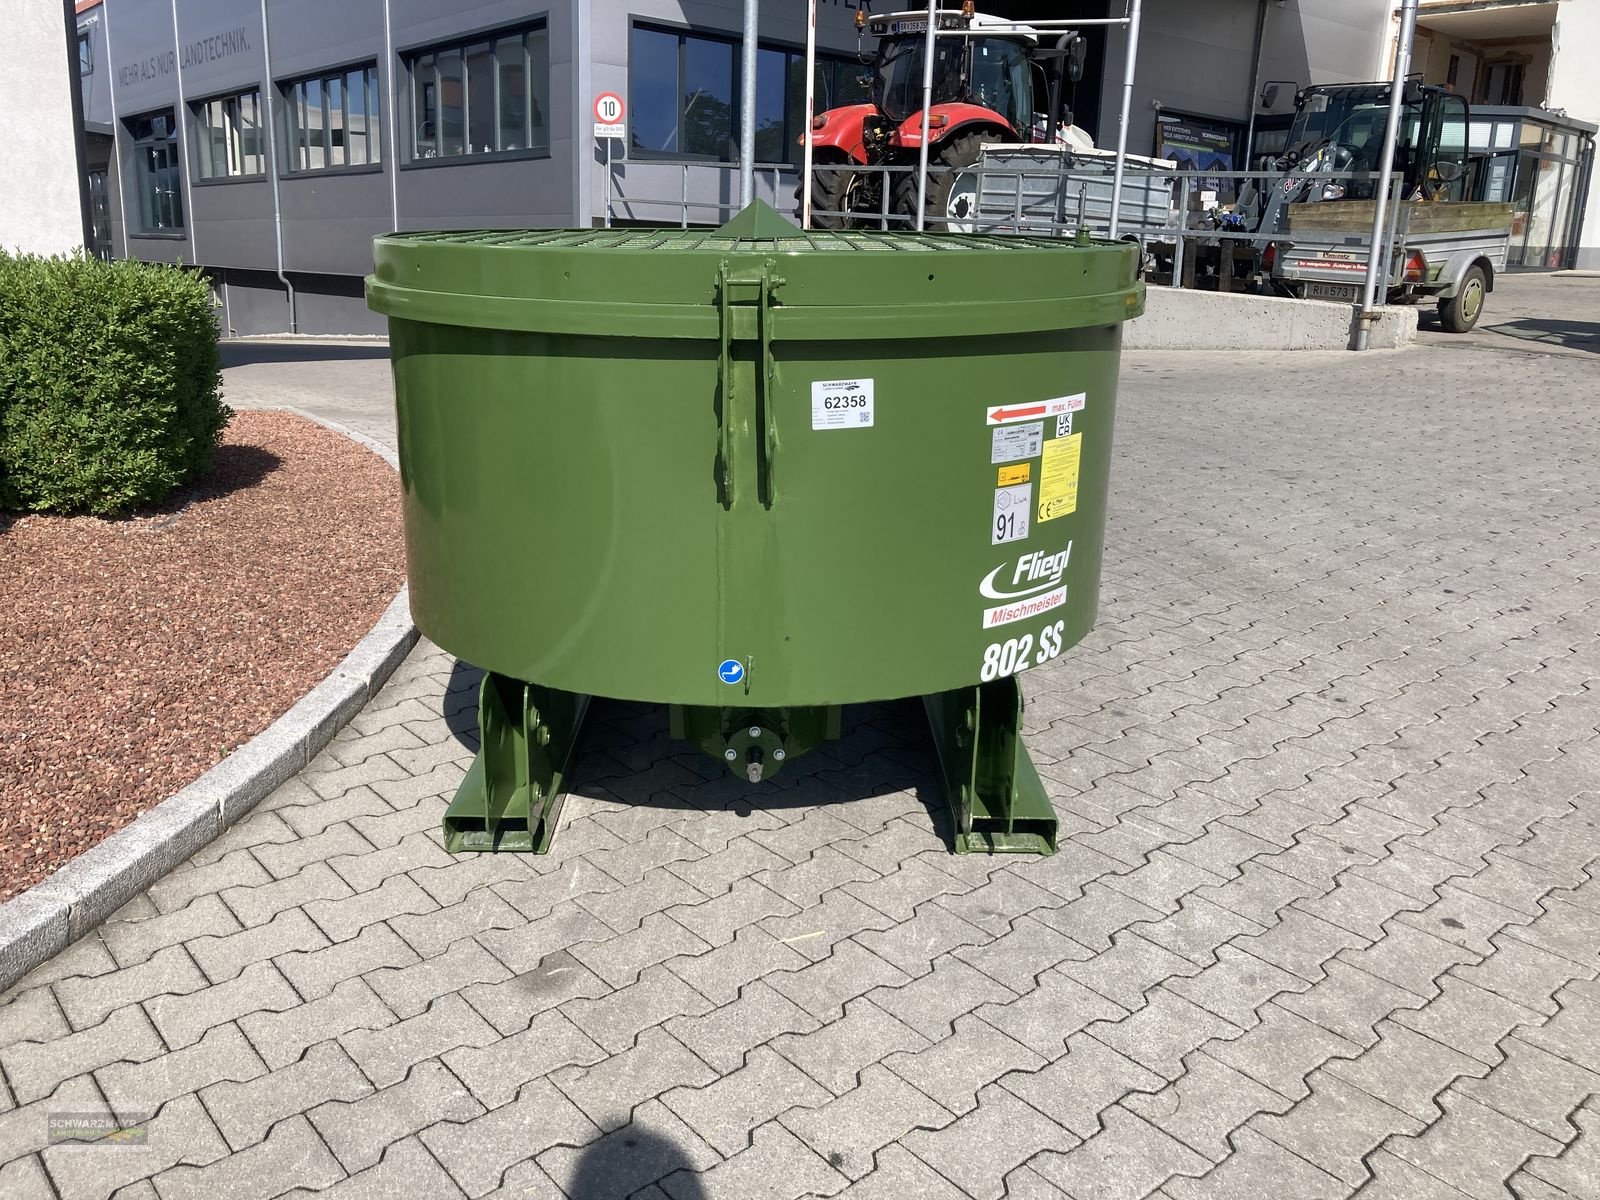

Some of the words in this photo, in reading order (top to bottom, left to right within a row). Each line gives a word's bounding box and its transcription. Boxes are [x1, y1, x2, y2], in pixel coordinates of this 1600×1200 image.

[118, 63, 139, 88] MEHR
[140, 58, 156, 81] ALS
[157, 51, 176, 76] NUR
[180, 26, 251, 70] LANDTECHNIK.
[603, 101, 615, 116] 10
[1313, 285, 1322, 295] RI
[1330, 286, 1348, 297] 573
[824, 395, 867, 409] 62358
[1052, 404, 1066, 412] max.
[1059, 413, 1070, 425] UK
[1058, 425, 1070, 436] CA
[996, 511, 1014, 540] 91
[1012, 540, 1073, 585] Fliegl
[990, 592, 1064, 625] Mischmeister
[980, 633, 1033, 682] 802
[1036, 619, 1065, 664] SS
